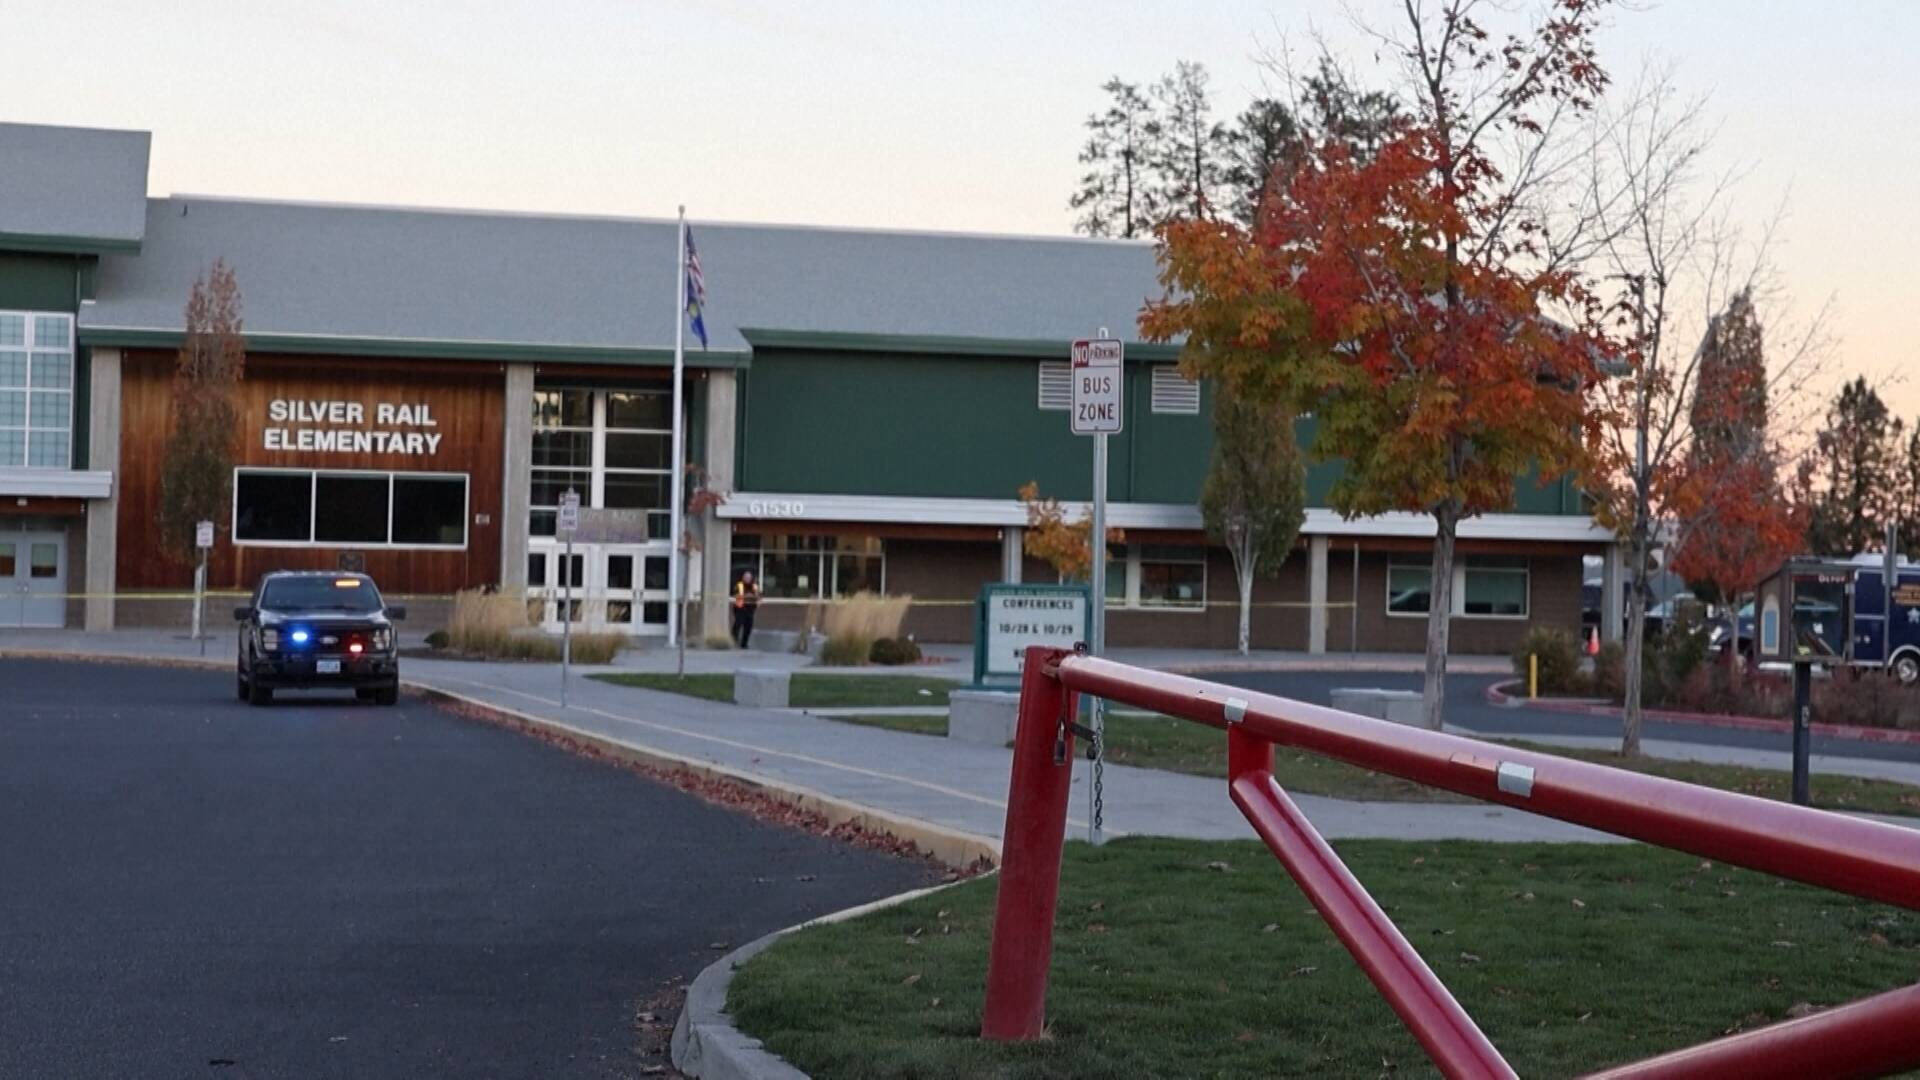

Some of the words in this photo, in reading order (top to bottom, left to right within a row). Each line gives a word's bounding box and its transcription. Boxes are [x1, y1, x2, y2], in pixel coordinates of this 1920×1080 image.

[1074, 345, 1088, 363] NO
[1083, 377, 1111, 394] BUS
[269, 400, 364, 424] SILVER
[377, 403, 437, 426] RAIL
[1079, 403, 1115, 420] ZONE
[263, 428, 442, 455] ELEMENTARY
[750, 500, 804, 516] 61530
[1003, 599, 1074, 610] CONFERENCES
[1044, 624, 1074, 635] 10/29
